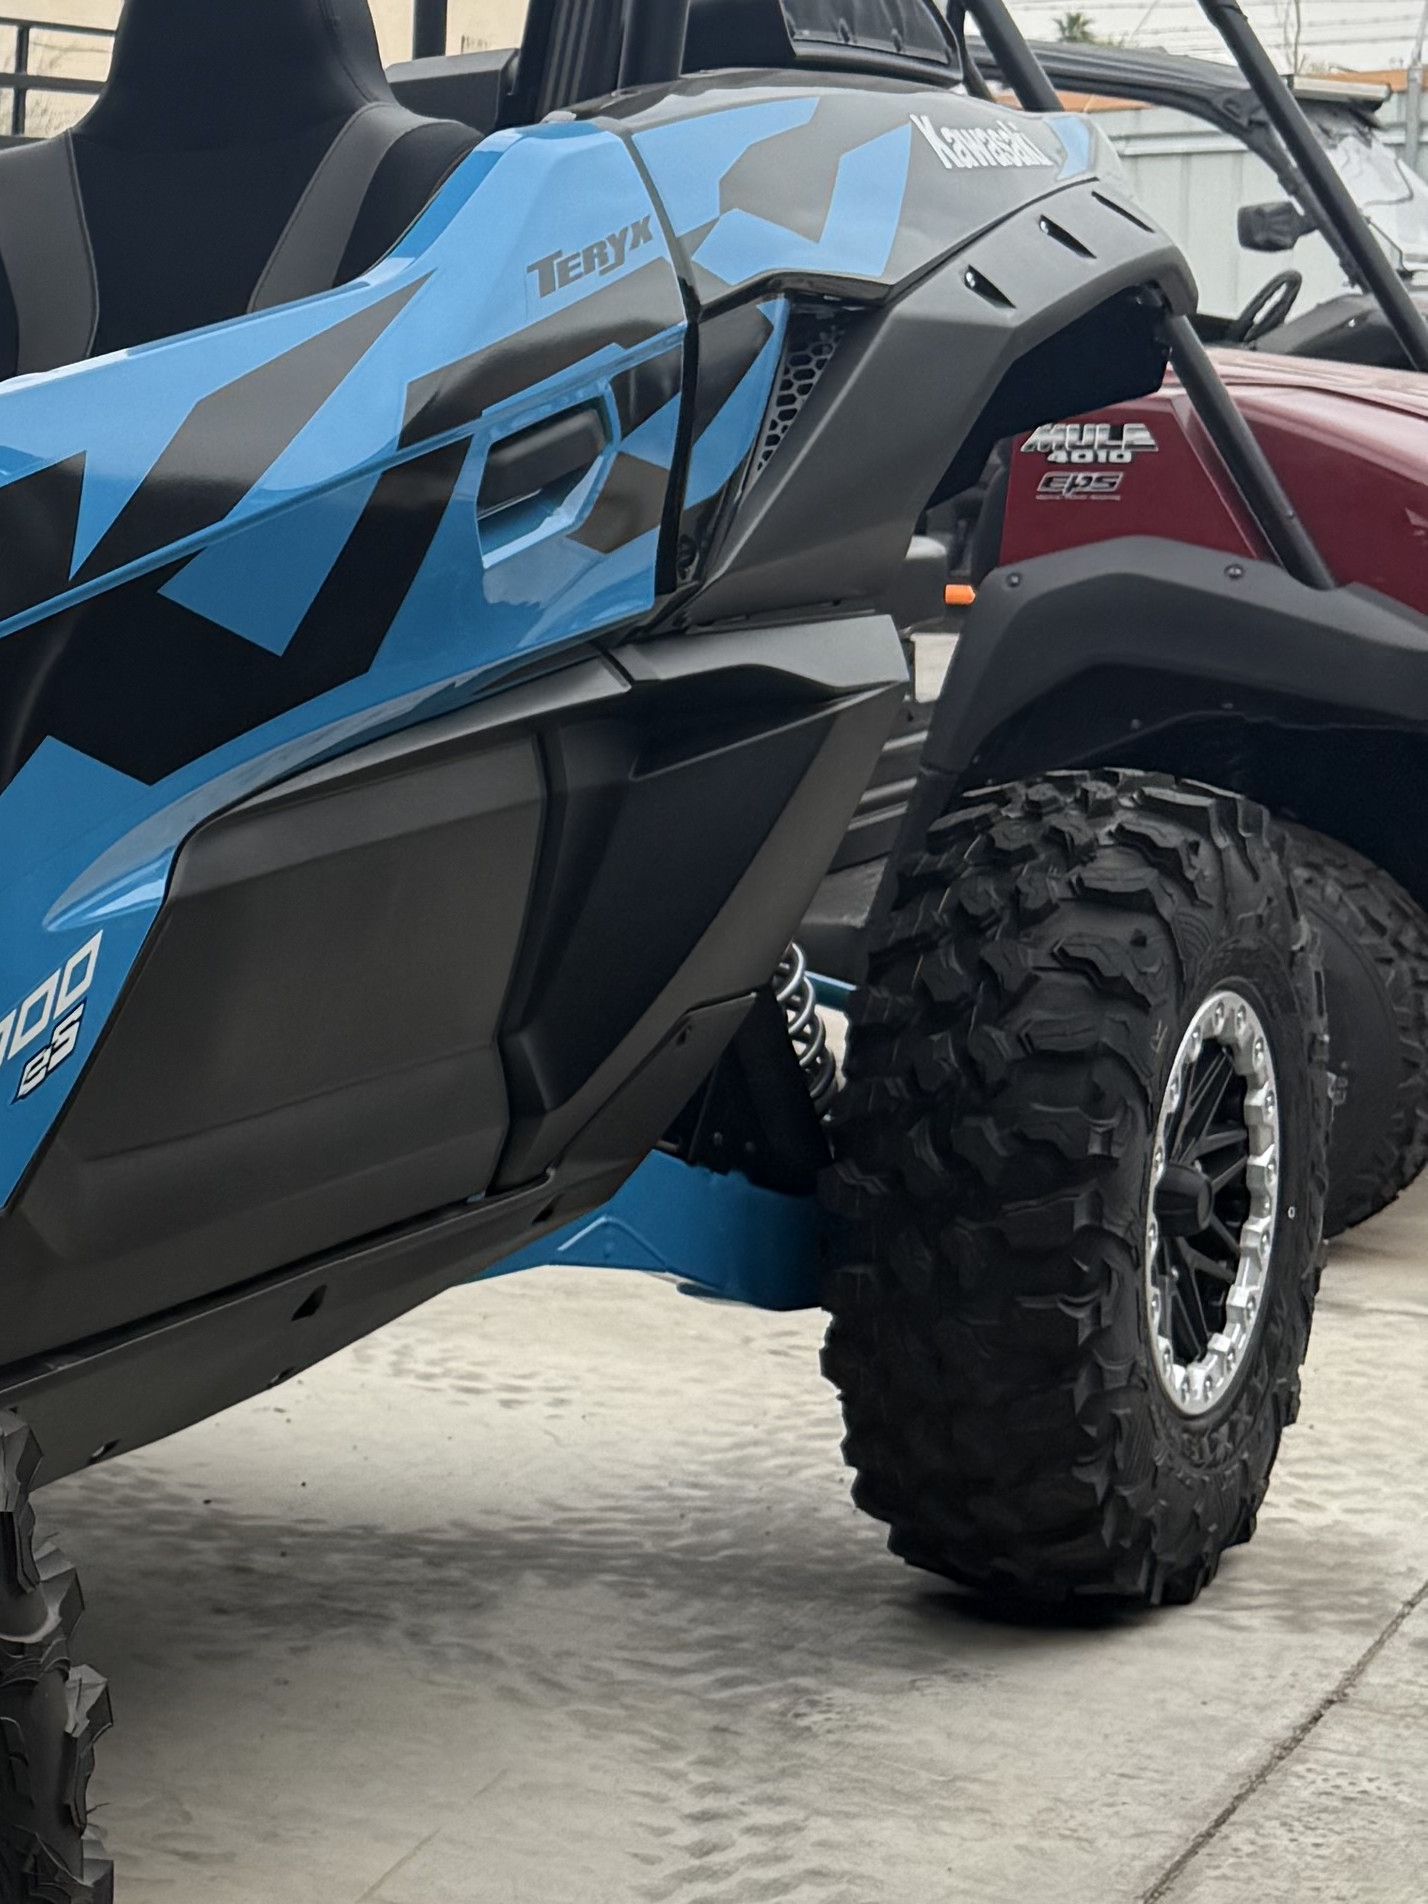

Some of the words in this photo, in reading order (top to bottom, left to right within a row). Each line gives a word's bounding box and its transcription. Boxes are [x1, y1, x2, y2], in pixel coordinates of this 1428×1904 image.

[909, 114, 1054, 169] Kawasaki
[1020, 423, 1159, 452] MULE
[1047, 449, 1132, 463] 4010
